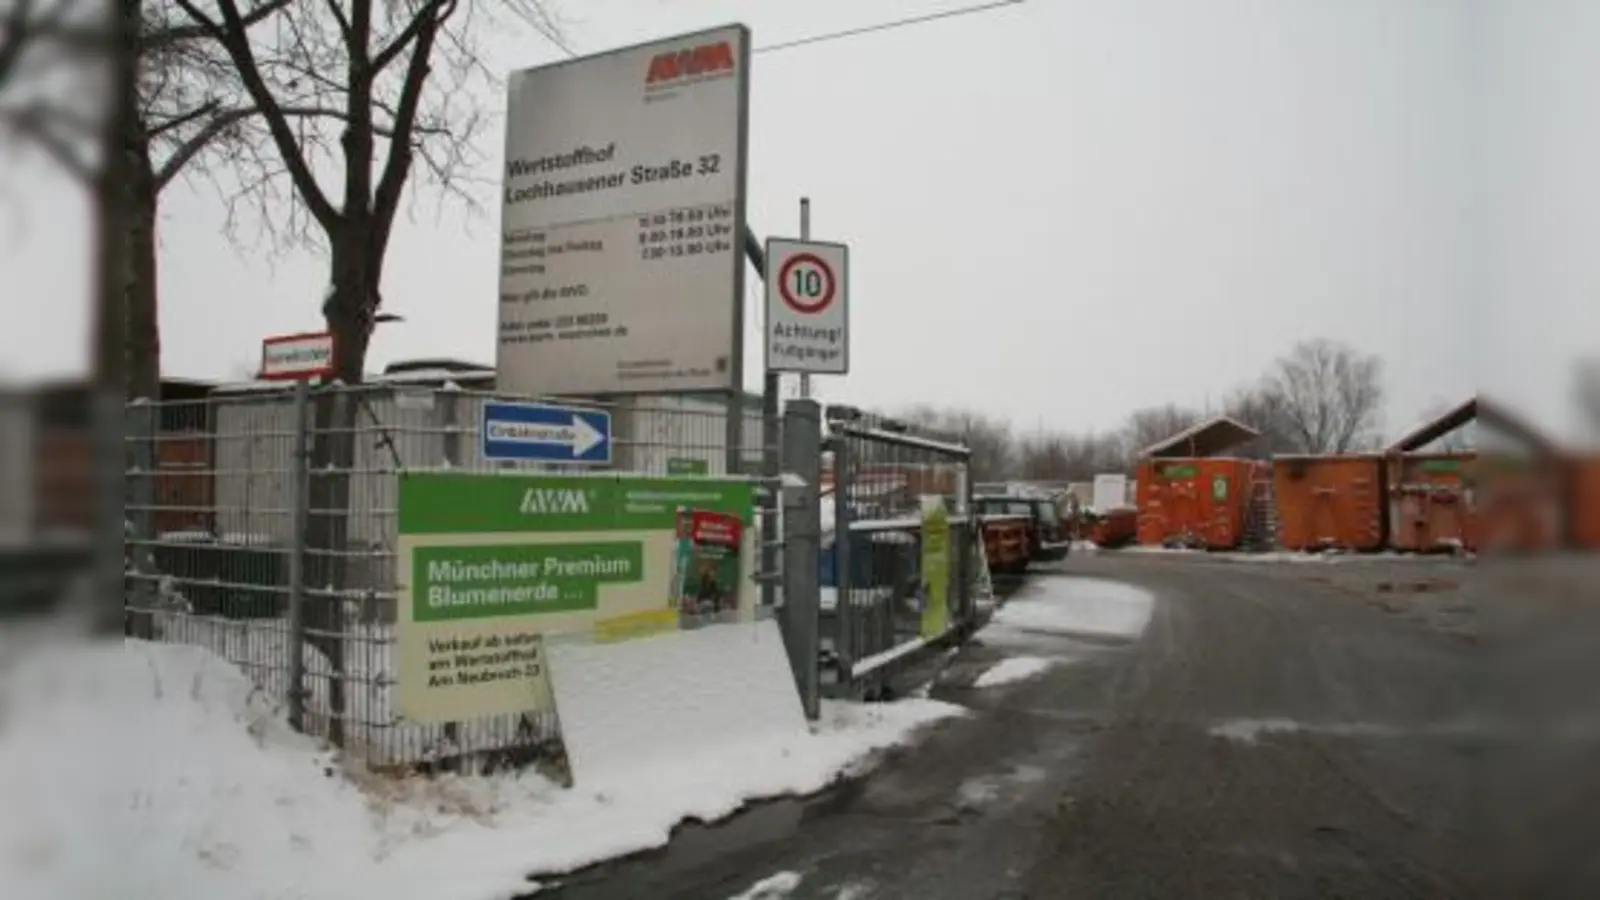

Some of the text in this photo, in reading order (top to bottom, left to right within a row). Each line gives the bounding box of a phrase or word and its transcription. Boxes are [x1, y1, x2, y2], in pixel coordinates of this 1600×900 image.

[505, 142, 615, 179] Wertstoffhof
[504, 154, 722, 204] Lochhausener Straße 32
[793, 269, 822, 297] 10
[773, 322, 842, 344] Achtung!
[520, 488, 589, 513] AWM
[428, 555, 631, 582] Münchner Premium
[428, 582, 559, 608] Blumenerde
[428, 633, 482, 653] Verkauf
[484, 635, 501, 648] ab
[429, 675, 454, 687] Am
